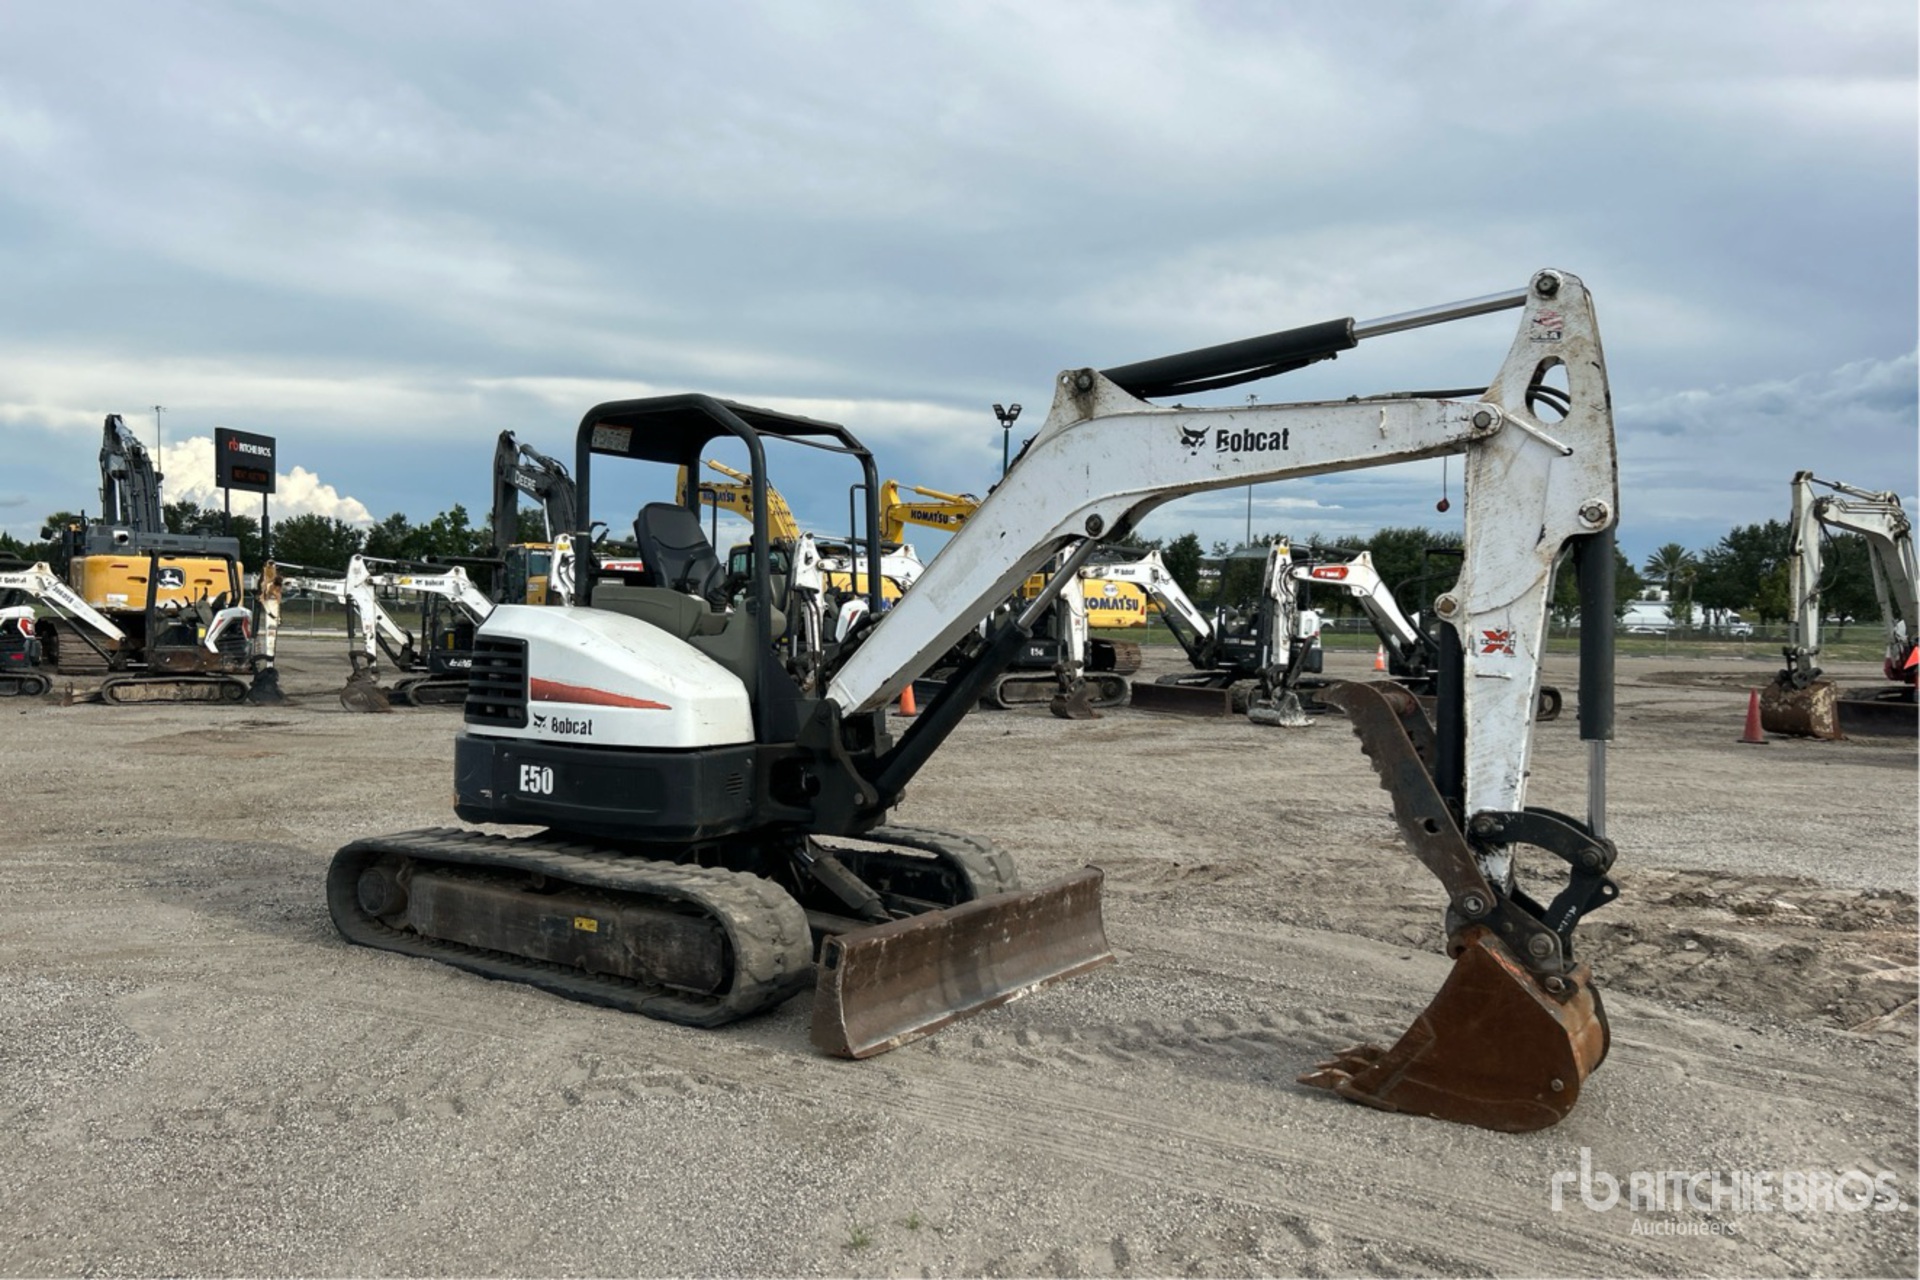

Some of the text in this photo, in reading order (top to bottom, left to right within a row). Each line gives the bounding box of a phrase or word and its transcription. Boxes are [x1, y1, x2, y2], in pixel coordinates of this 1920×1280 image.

[1216, 427, 1290, 453] Bobcat
[514, 470, 537, 492] DEERE
[910, 509, 949, 524] KOMATSU
[551, 716, 593, 735] Bobcat
[519, 764, 554, 795] E50
